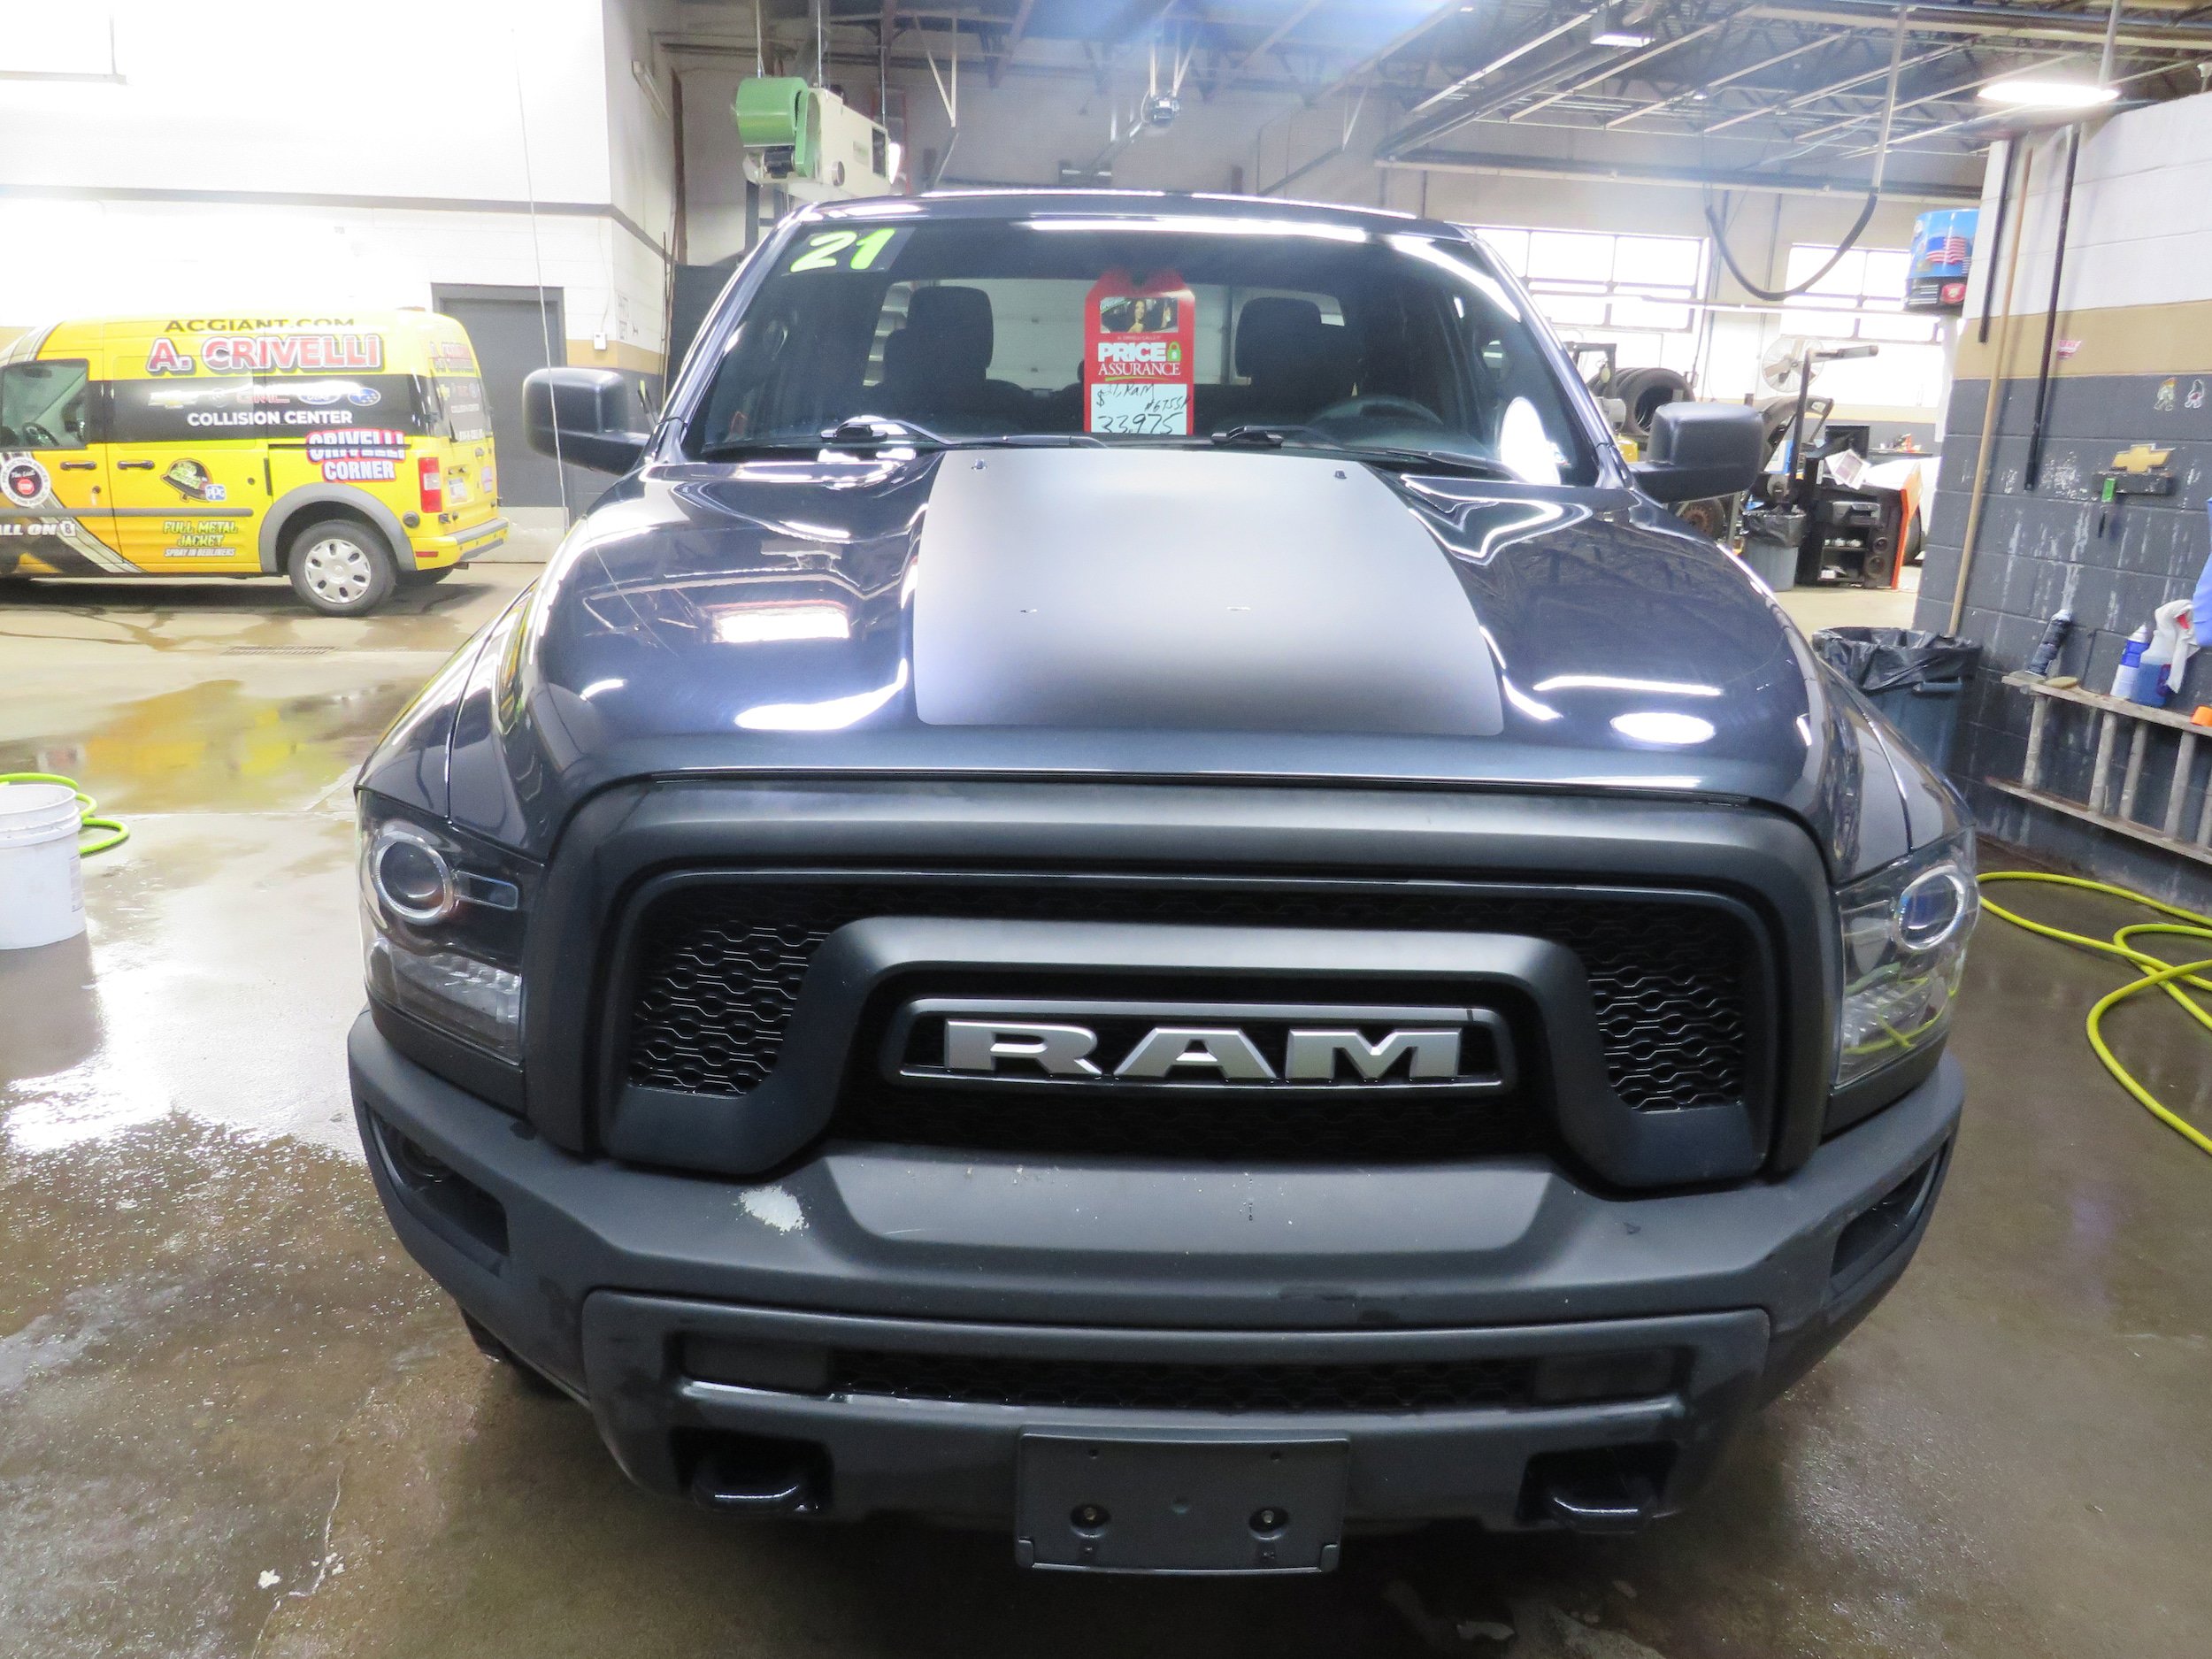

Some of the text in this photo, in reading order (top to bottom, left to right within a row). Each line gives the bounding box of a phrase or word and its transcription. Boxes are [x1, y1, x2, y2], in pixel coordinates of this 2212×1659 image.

[790, 228, 895, 273] 21
[202, 334, 381, 369] CRIVELLI
[1098, 342, 1166, 362] PRICE
[1098, 363, 1180, 376] ASSURANCE
[1096, 389, 1104, 407] $
[187, 410, 353, 426] COLLISION CENTER
[308, 430, 405, 461] CRIVELLI
[324, 460, 396, 480] CORNER
[27, 524, 57, 535] ON
[163, 521, 237, 534] FULL METAL
[178, 534, 223, 547] JACKET
[944, 1020, 1463, 1083] RAM
